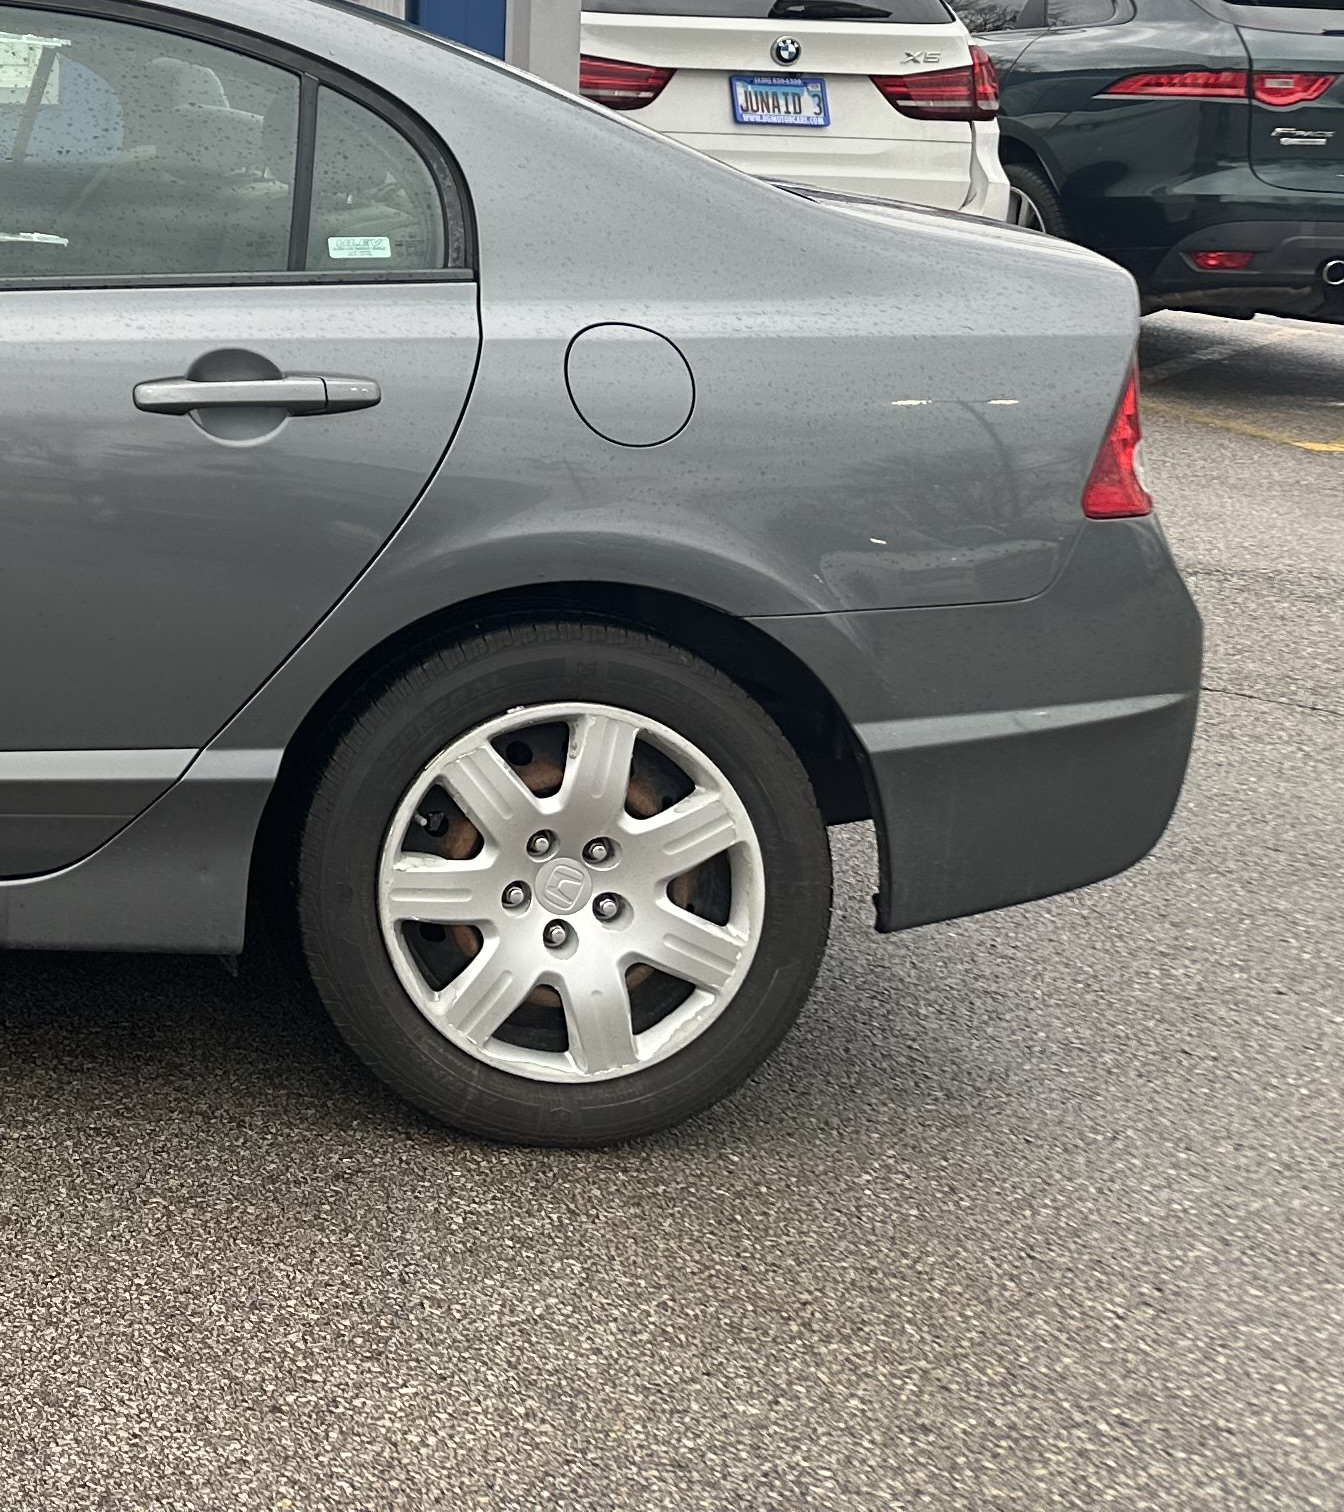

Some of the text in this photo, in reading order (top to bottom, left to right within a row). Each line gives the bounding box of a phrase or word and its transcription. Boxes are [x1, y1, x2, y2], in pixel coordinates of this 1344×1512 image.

[900, 51, 942, 64] X5
[740, 90, 823, 116] JUNAID 3
